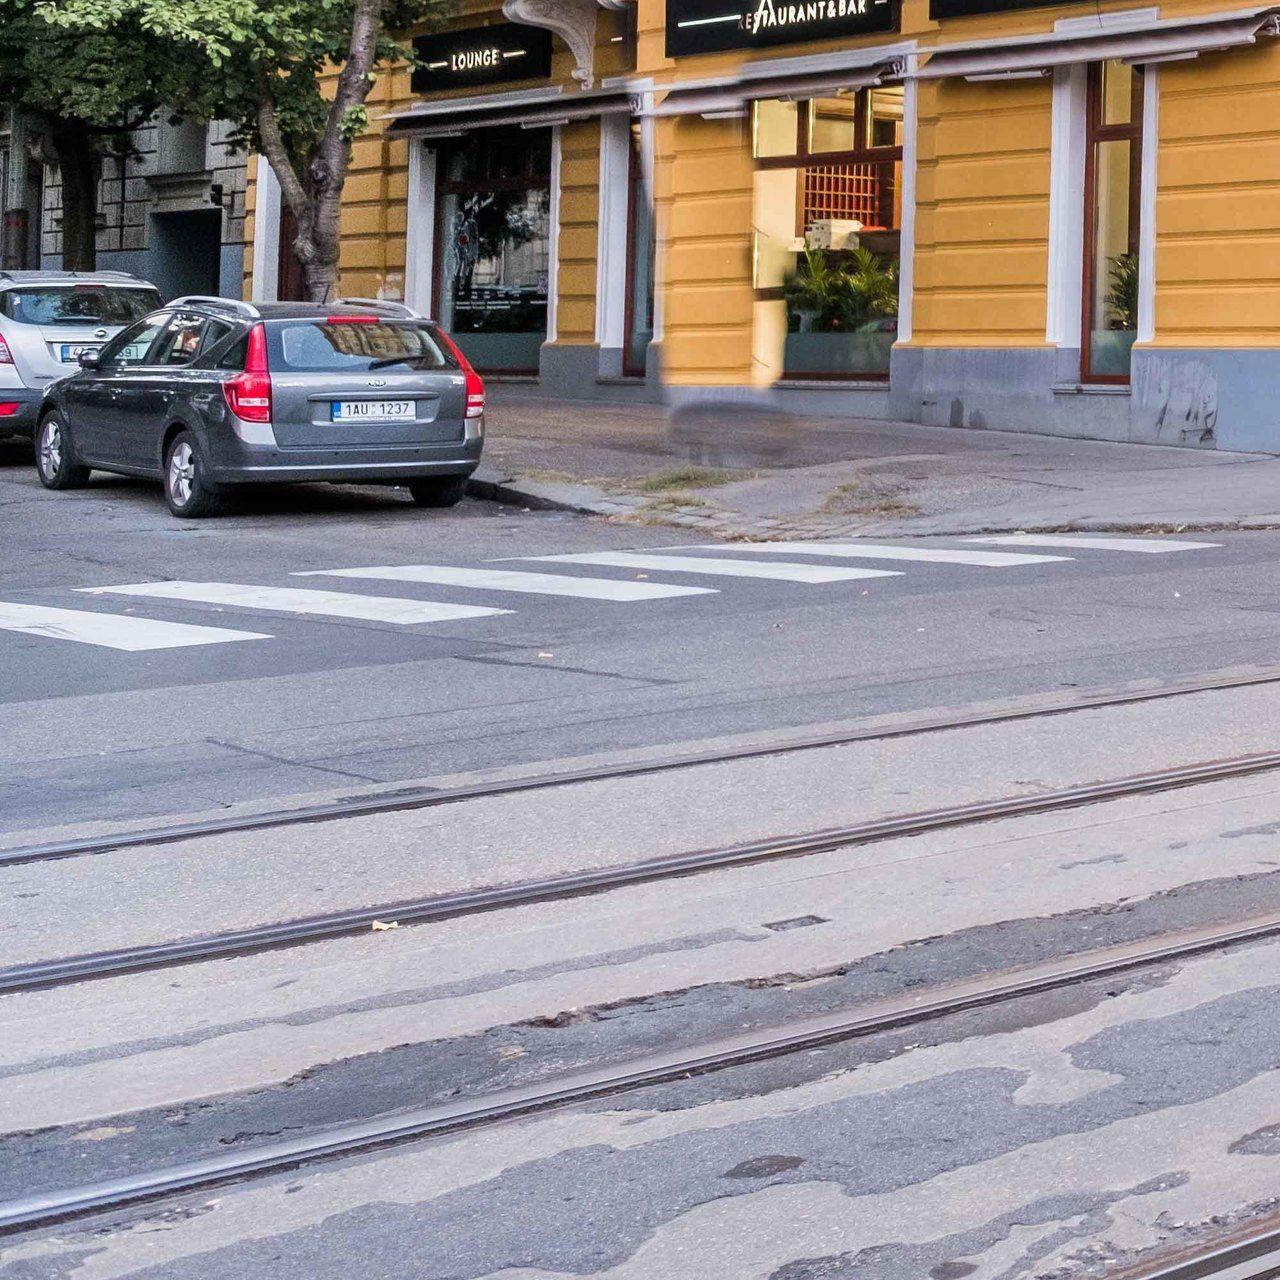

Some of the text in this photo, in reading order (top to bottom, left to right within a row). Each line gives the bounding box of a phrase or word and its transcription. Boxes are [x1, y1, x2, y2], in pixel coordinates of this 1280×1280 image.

[452, 48, 499, 71] LOUNGE
[346, 402, 409, 416] 1AU 1237
